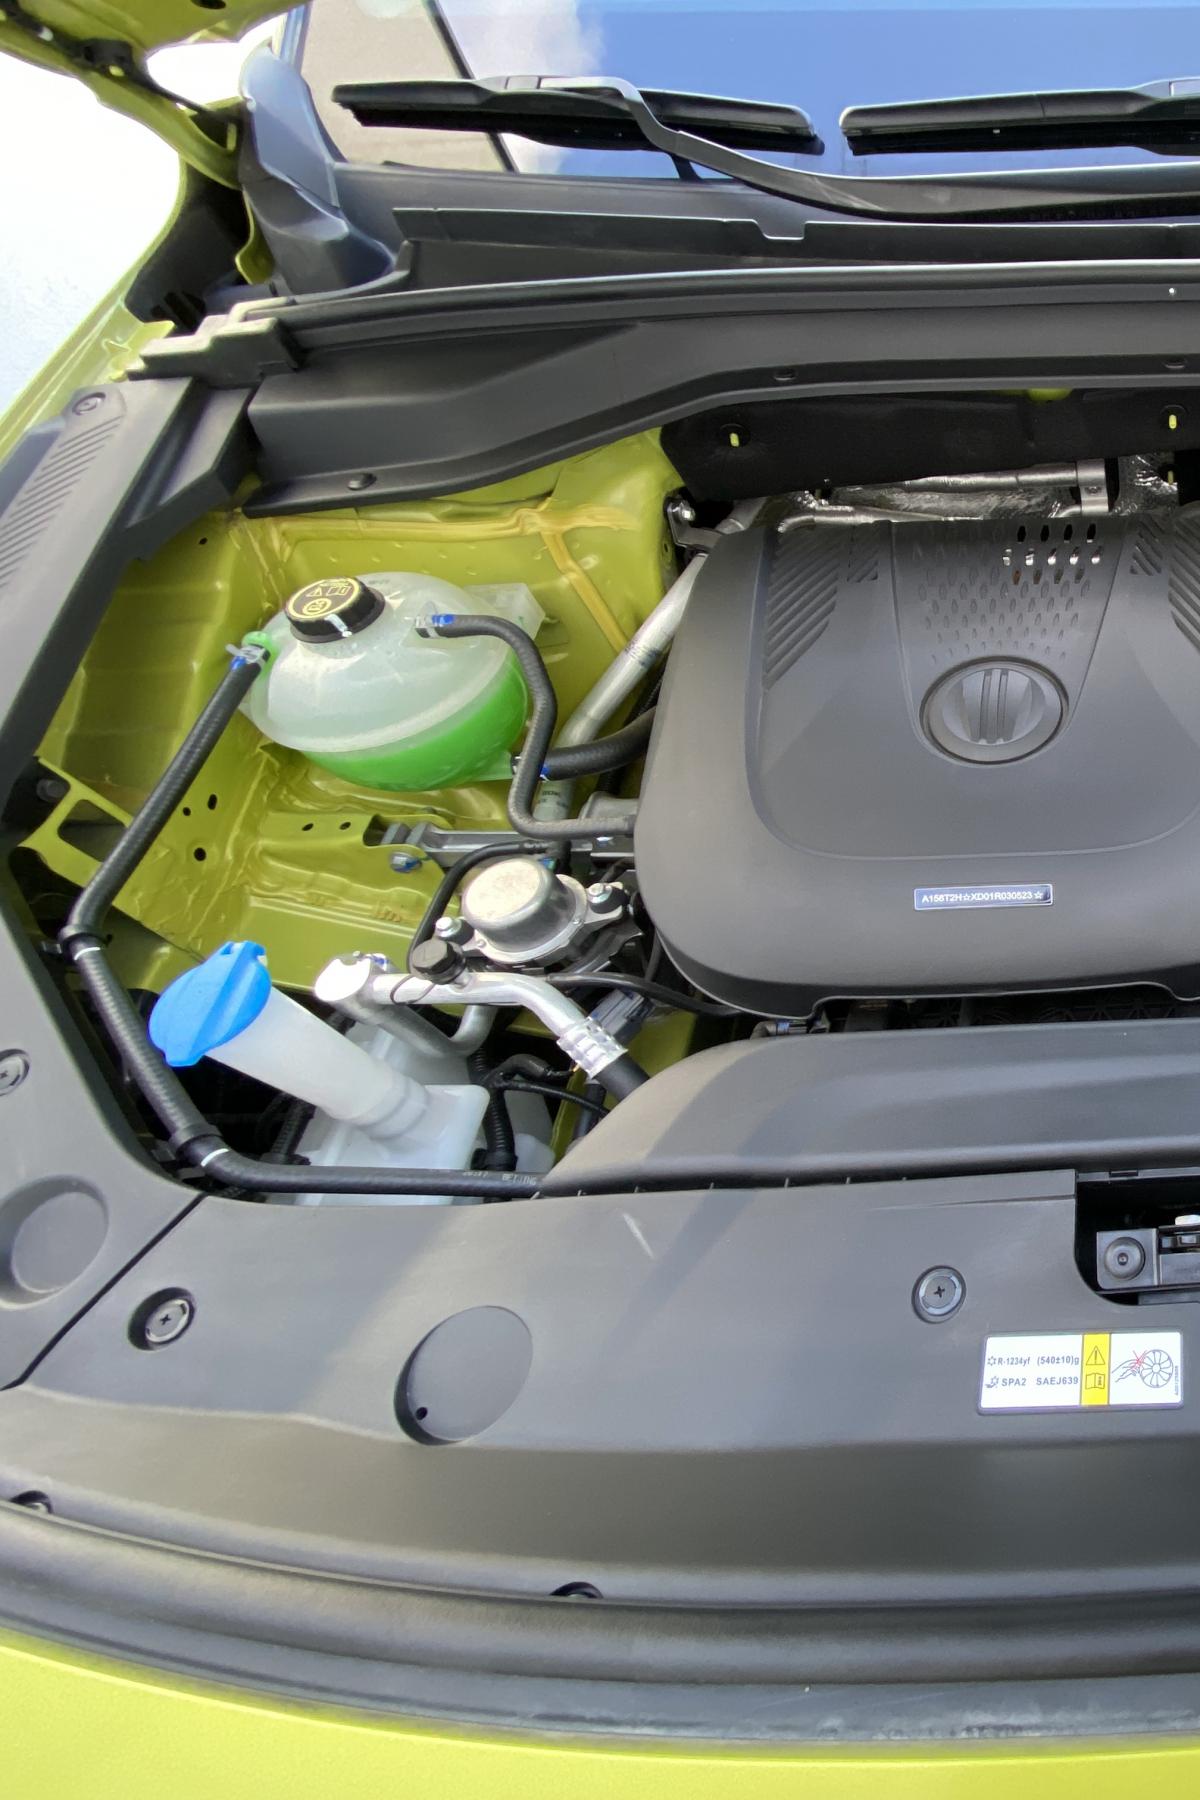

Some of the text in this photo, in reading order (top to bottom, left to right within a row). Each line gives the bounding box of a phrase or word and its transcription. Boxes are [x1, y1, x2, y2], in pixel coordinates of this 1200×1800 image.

[997, 1355, 1080, 1367] R-1234yf (540±10)g
[1001, 1375, 1079, 1387] SPA2 SAEJ639
